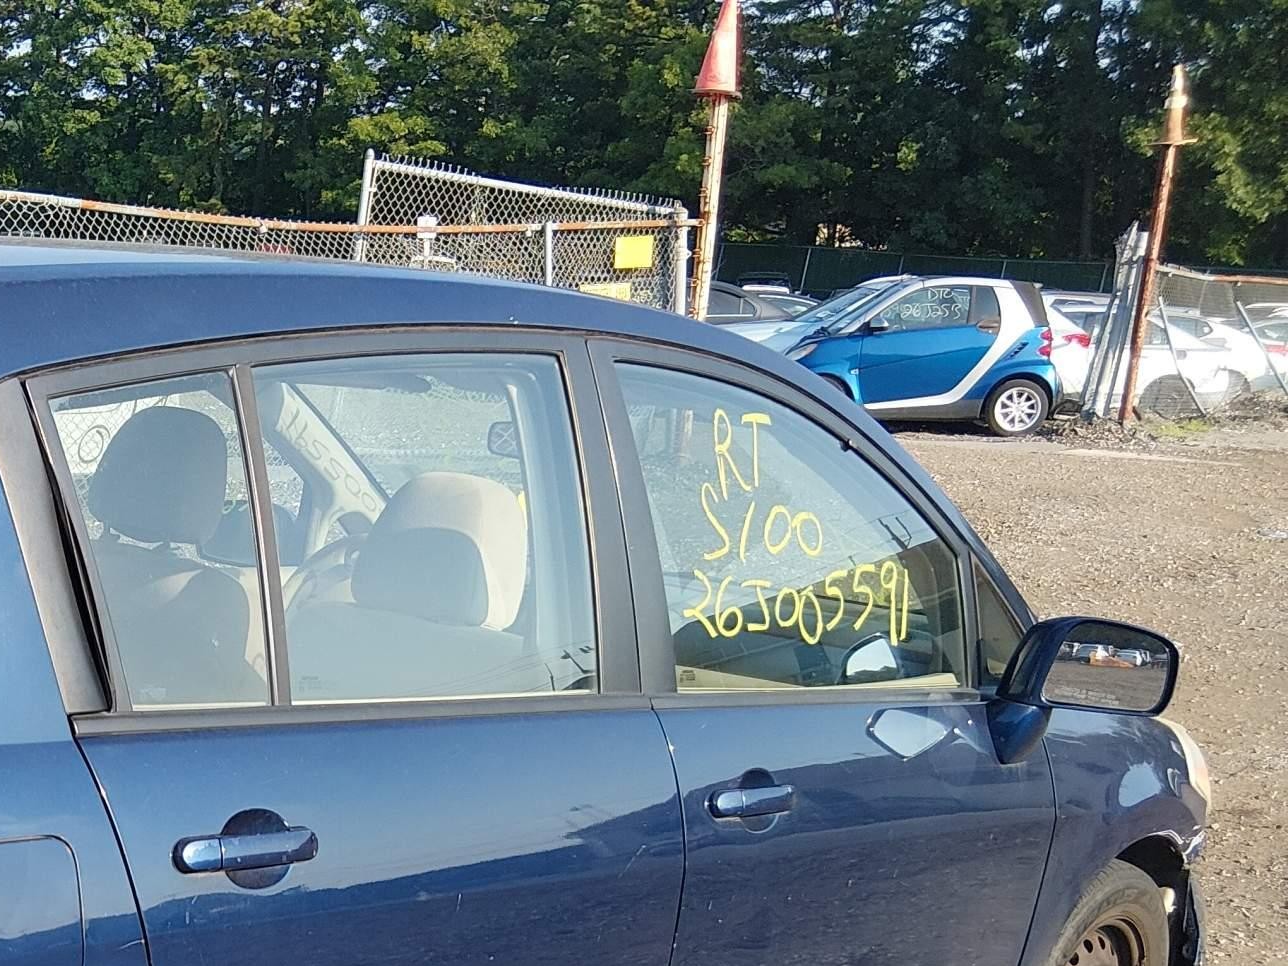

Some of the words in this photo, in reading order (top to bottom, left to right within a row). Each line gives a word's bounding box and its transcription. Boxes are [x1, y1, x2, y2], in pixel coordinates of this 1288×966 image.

[713, 408, 772, 499] RT
[700, 482, 824, 564] S100
[682, 560, 909, 646] 26J005591
